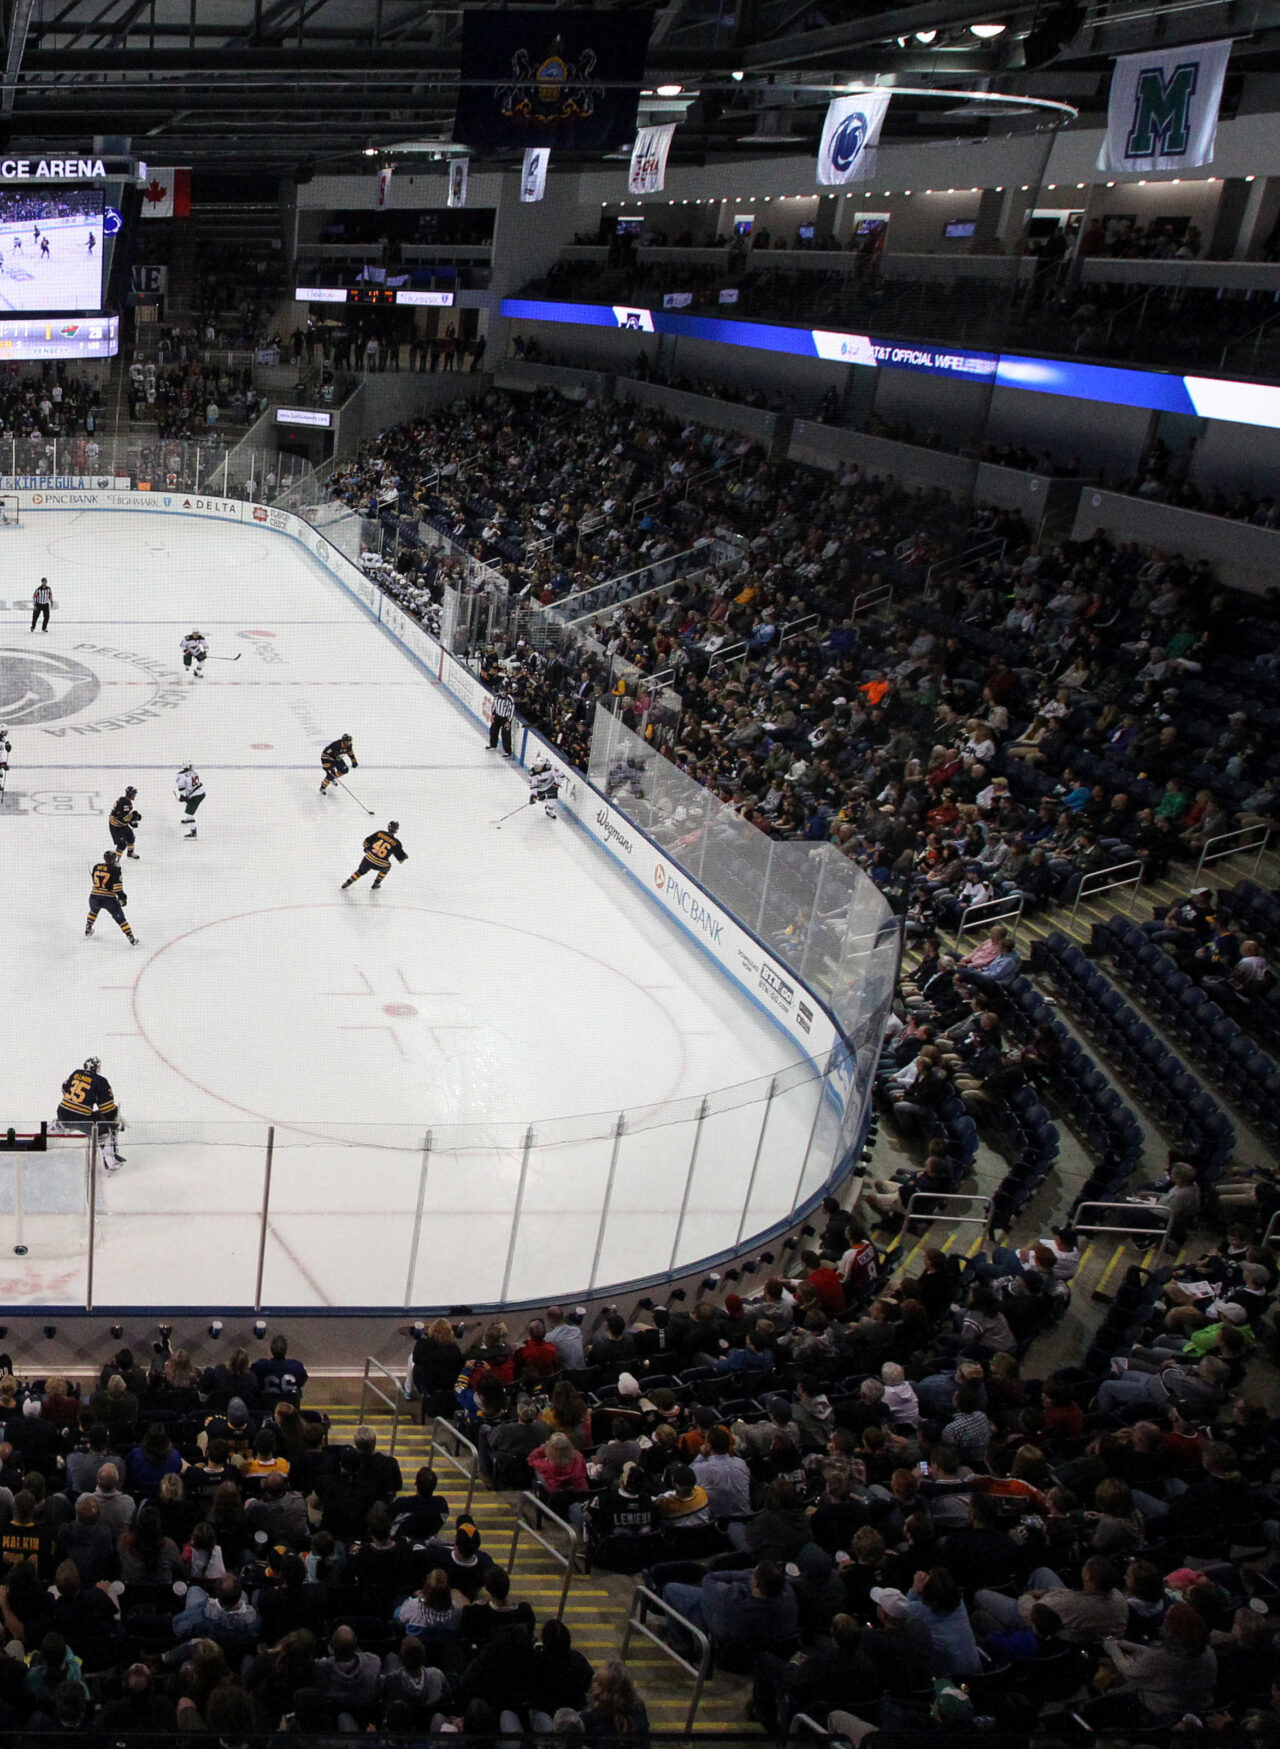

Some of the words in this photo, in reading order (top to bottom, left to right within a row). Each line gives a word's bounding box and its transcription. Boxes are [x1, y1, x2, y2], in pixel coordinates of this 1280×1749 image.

[1124, 62, 1200, 160] M
[36, 160, 106, 178] ARENA
[892, 348, 933, 367] OFFICIAL
[15, 476, 37, 489] KIM
[39, 476, 84, 489] PEGULA
[45, 495, 68, 504] PNC
[69, 495, 99, 505] BANK
[196, 501, 236, 513] DELTA
[73, 643, 179, 679] PEGULA
[151, 689, 190, 709] ICE
[42, 708, 161, 738] ARENA
[596, 807, 634, 855] Wegmans
[371, 839, 392, 858] 46
[666, 876, 691, 914] PNC
[690, 902, 724, 944] BANK
[64, 1079, 91, 1104] 35
[1, 1535, 41, 1551] MALKIN
